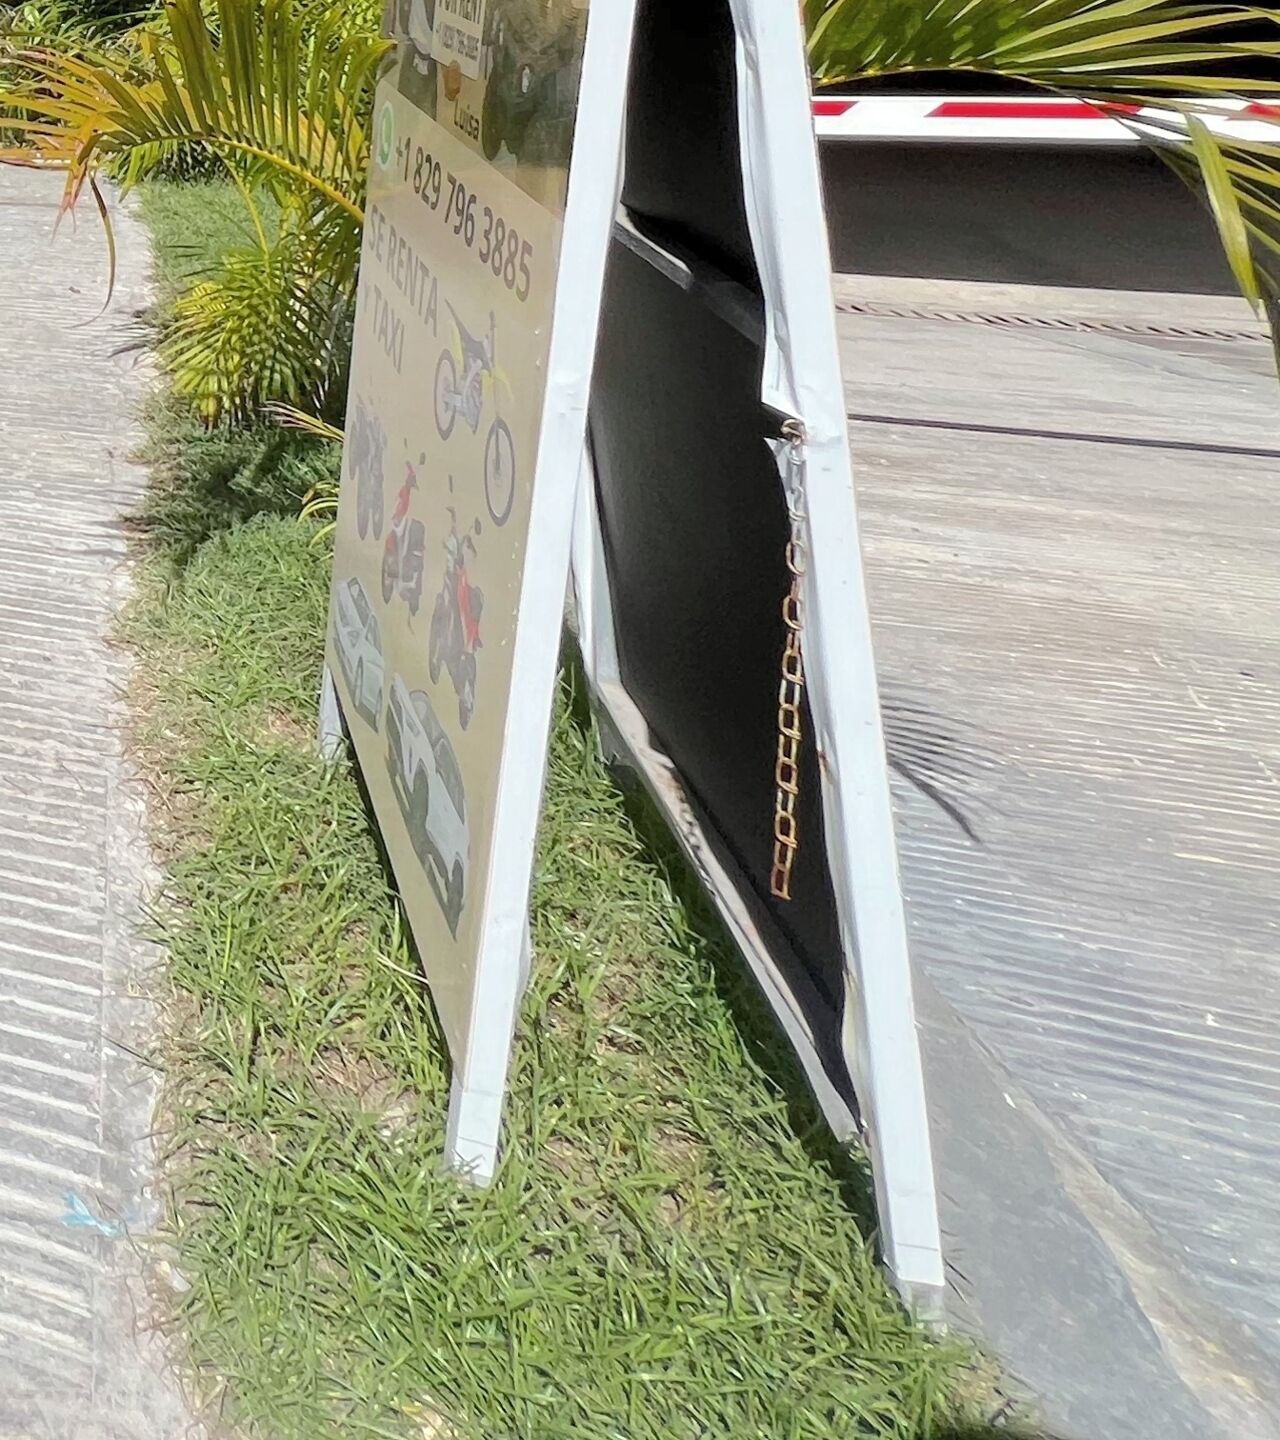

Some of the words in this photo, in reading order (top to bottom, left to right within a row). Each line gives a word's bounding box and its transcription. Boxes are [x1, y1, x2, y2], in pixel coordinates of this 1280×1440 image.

[453, 99, 480, 142] Luisa
[368, 204, 386, 263] SE
[386, 224, 439, 338] RENTA
[395, 136, 411, 182] +1
[413, 146, 441, 211] 829
[444, 171, 477, 248] 796
[479, 206, 534, 302] 3885
[372, 283, 406, 375] TAXI
